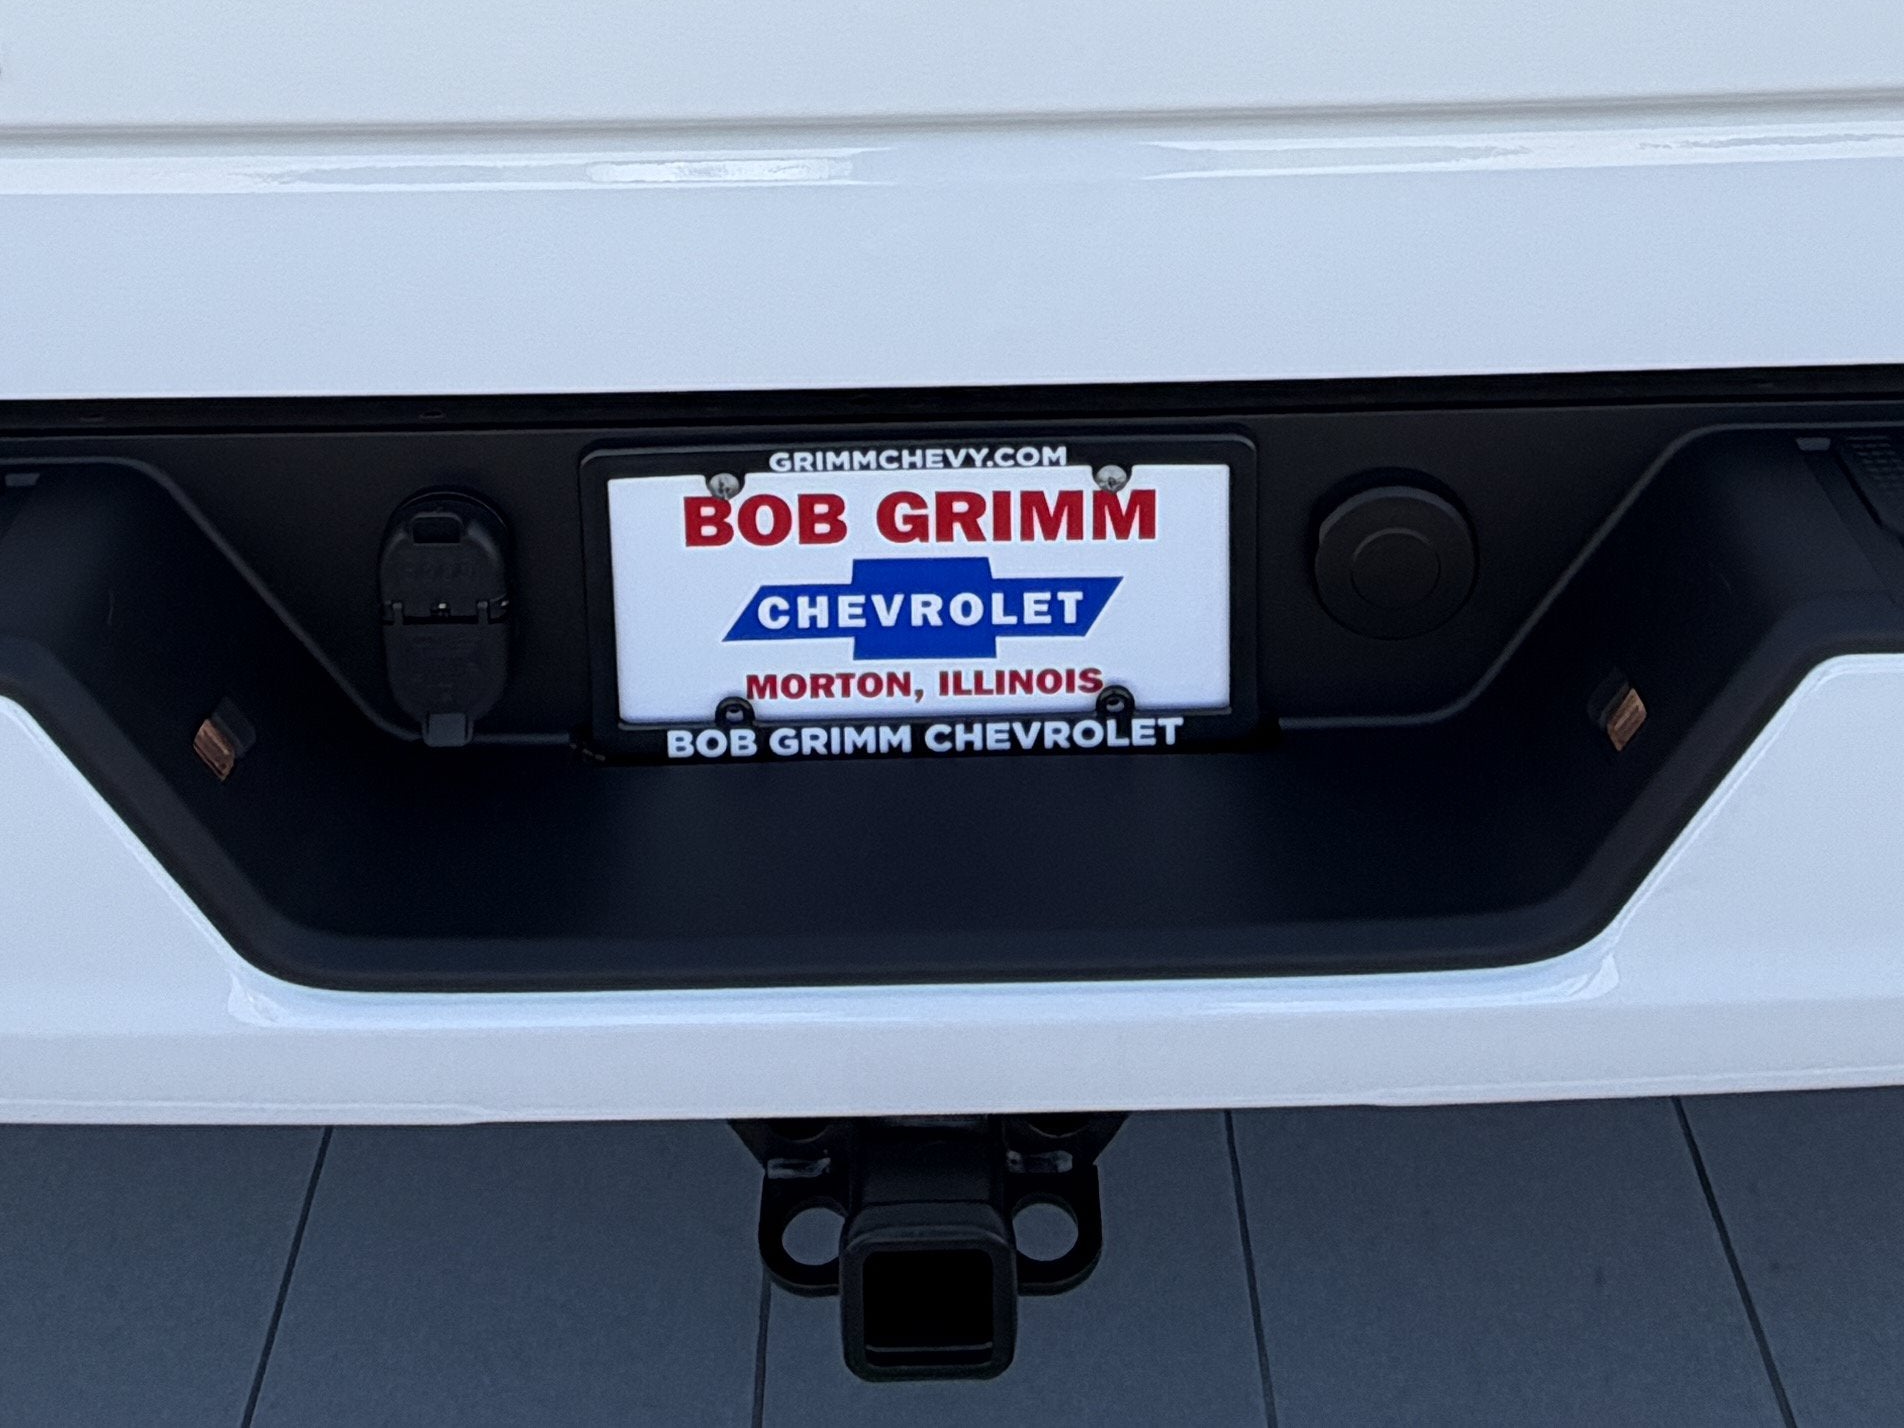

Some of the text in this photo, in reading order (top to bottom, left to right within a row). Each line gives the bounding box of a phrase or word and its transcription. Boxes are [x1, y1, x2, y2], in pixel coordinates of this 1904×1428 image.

[768, 445, 1068, 474] GRIMMCHEVY.COM
[683, 488, 1157, 548] BOB GRIMM
[757, 590, 1084, 631] CHEVROLET
[745, 667, 1104, 704] MORTON, ILLINOIS
[666, 717, 1184, 760] BOB GRIMM CHEVROLET
